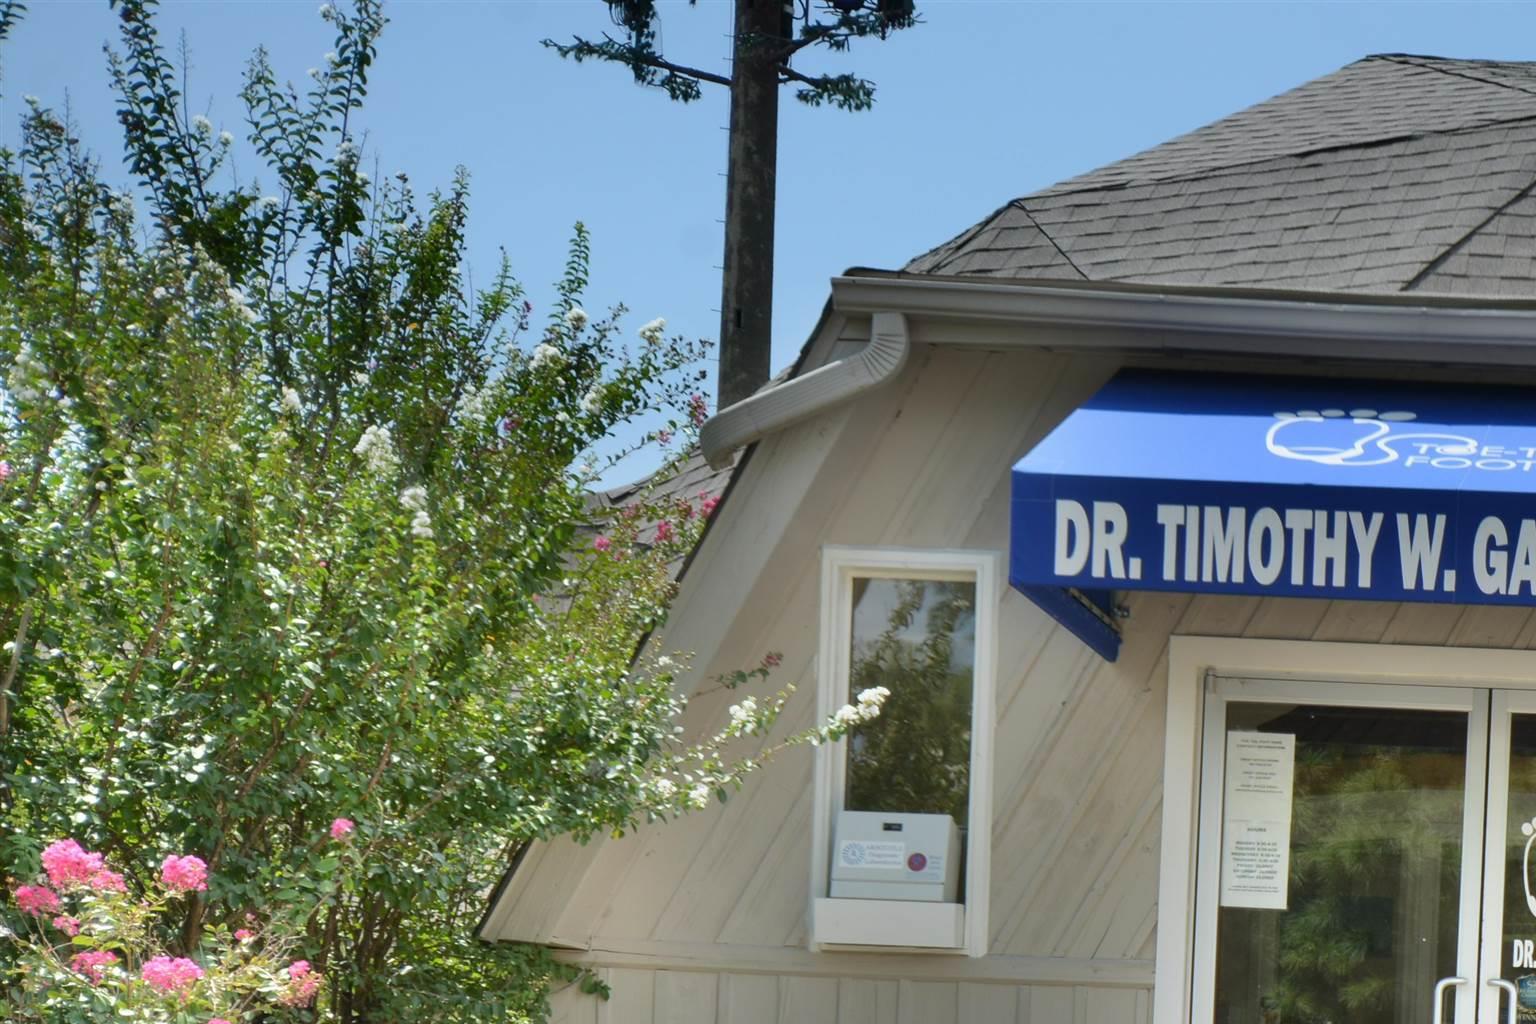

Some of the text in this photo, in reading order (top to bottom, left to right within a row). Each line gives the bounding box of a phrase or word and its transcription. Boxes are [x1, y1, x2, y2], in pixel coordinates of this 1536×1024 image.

[1054, 499, 1142, 580] DR.
[1157, 504, 1384, 589] TIMOTHY
[1396, 513, 1457, 592] W.
